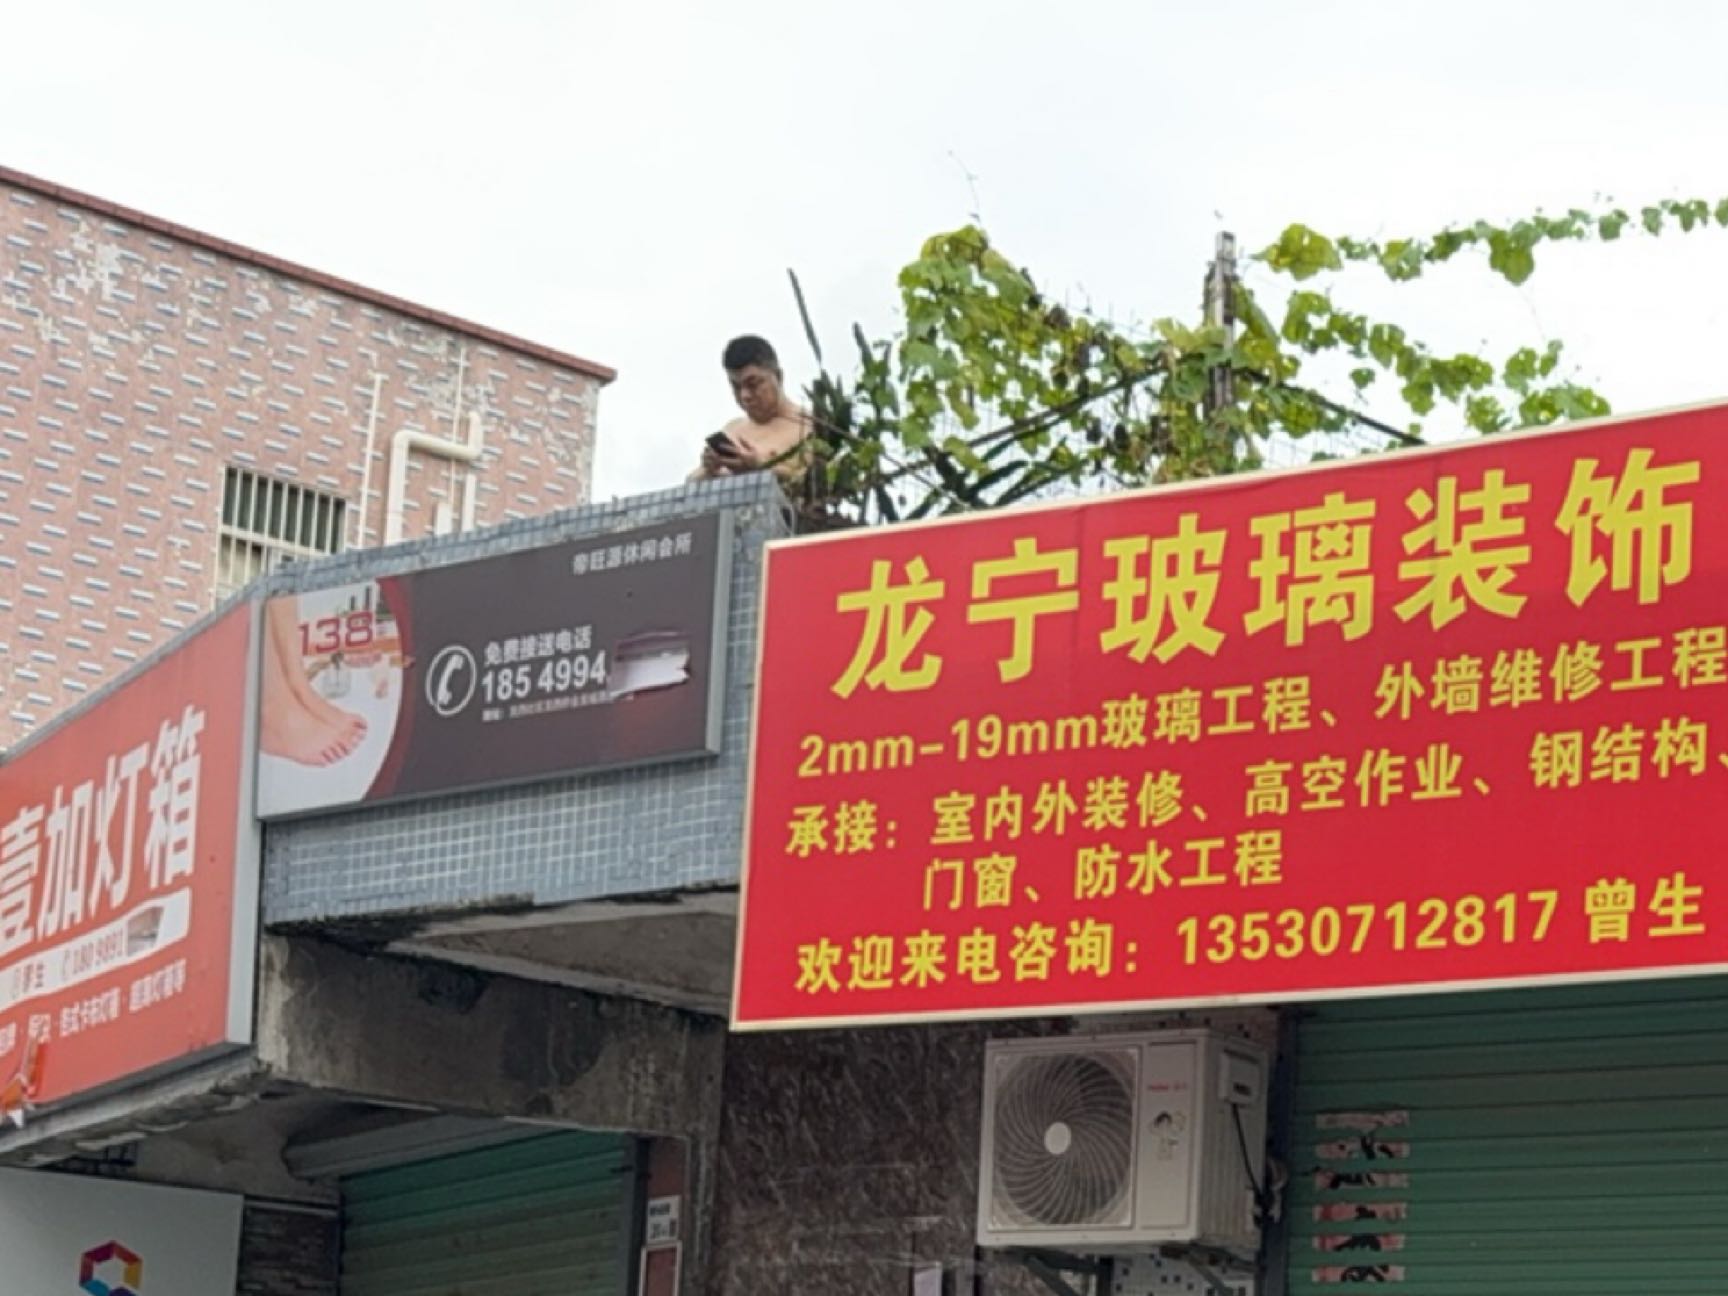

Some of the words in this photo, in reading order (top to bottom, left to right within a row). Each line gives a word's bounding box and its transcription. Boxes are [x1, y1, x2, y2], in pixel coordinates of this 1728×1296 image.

[832, 448, 1700, 698] 龙宁玻璃装饰
[297, 611, 373, 657] 138
[485, 624, 592, 666] 免费接送电话
[923, 830, 1281, 909] 门窗、防水工程
[1584, 872, 1705, 942] 曾生
